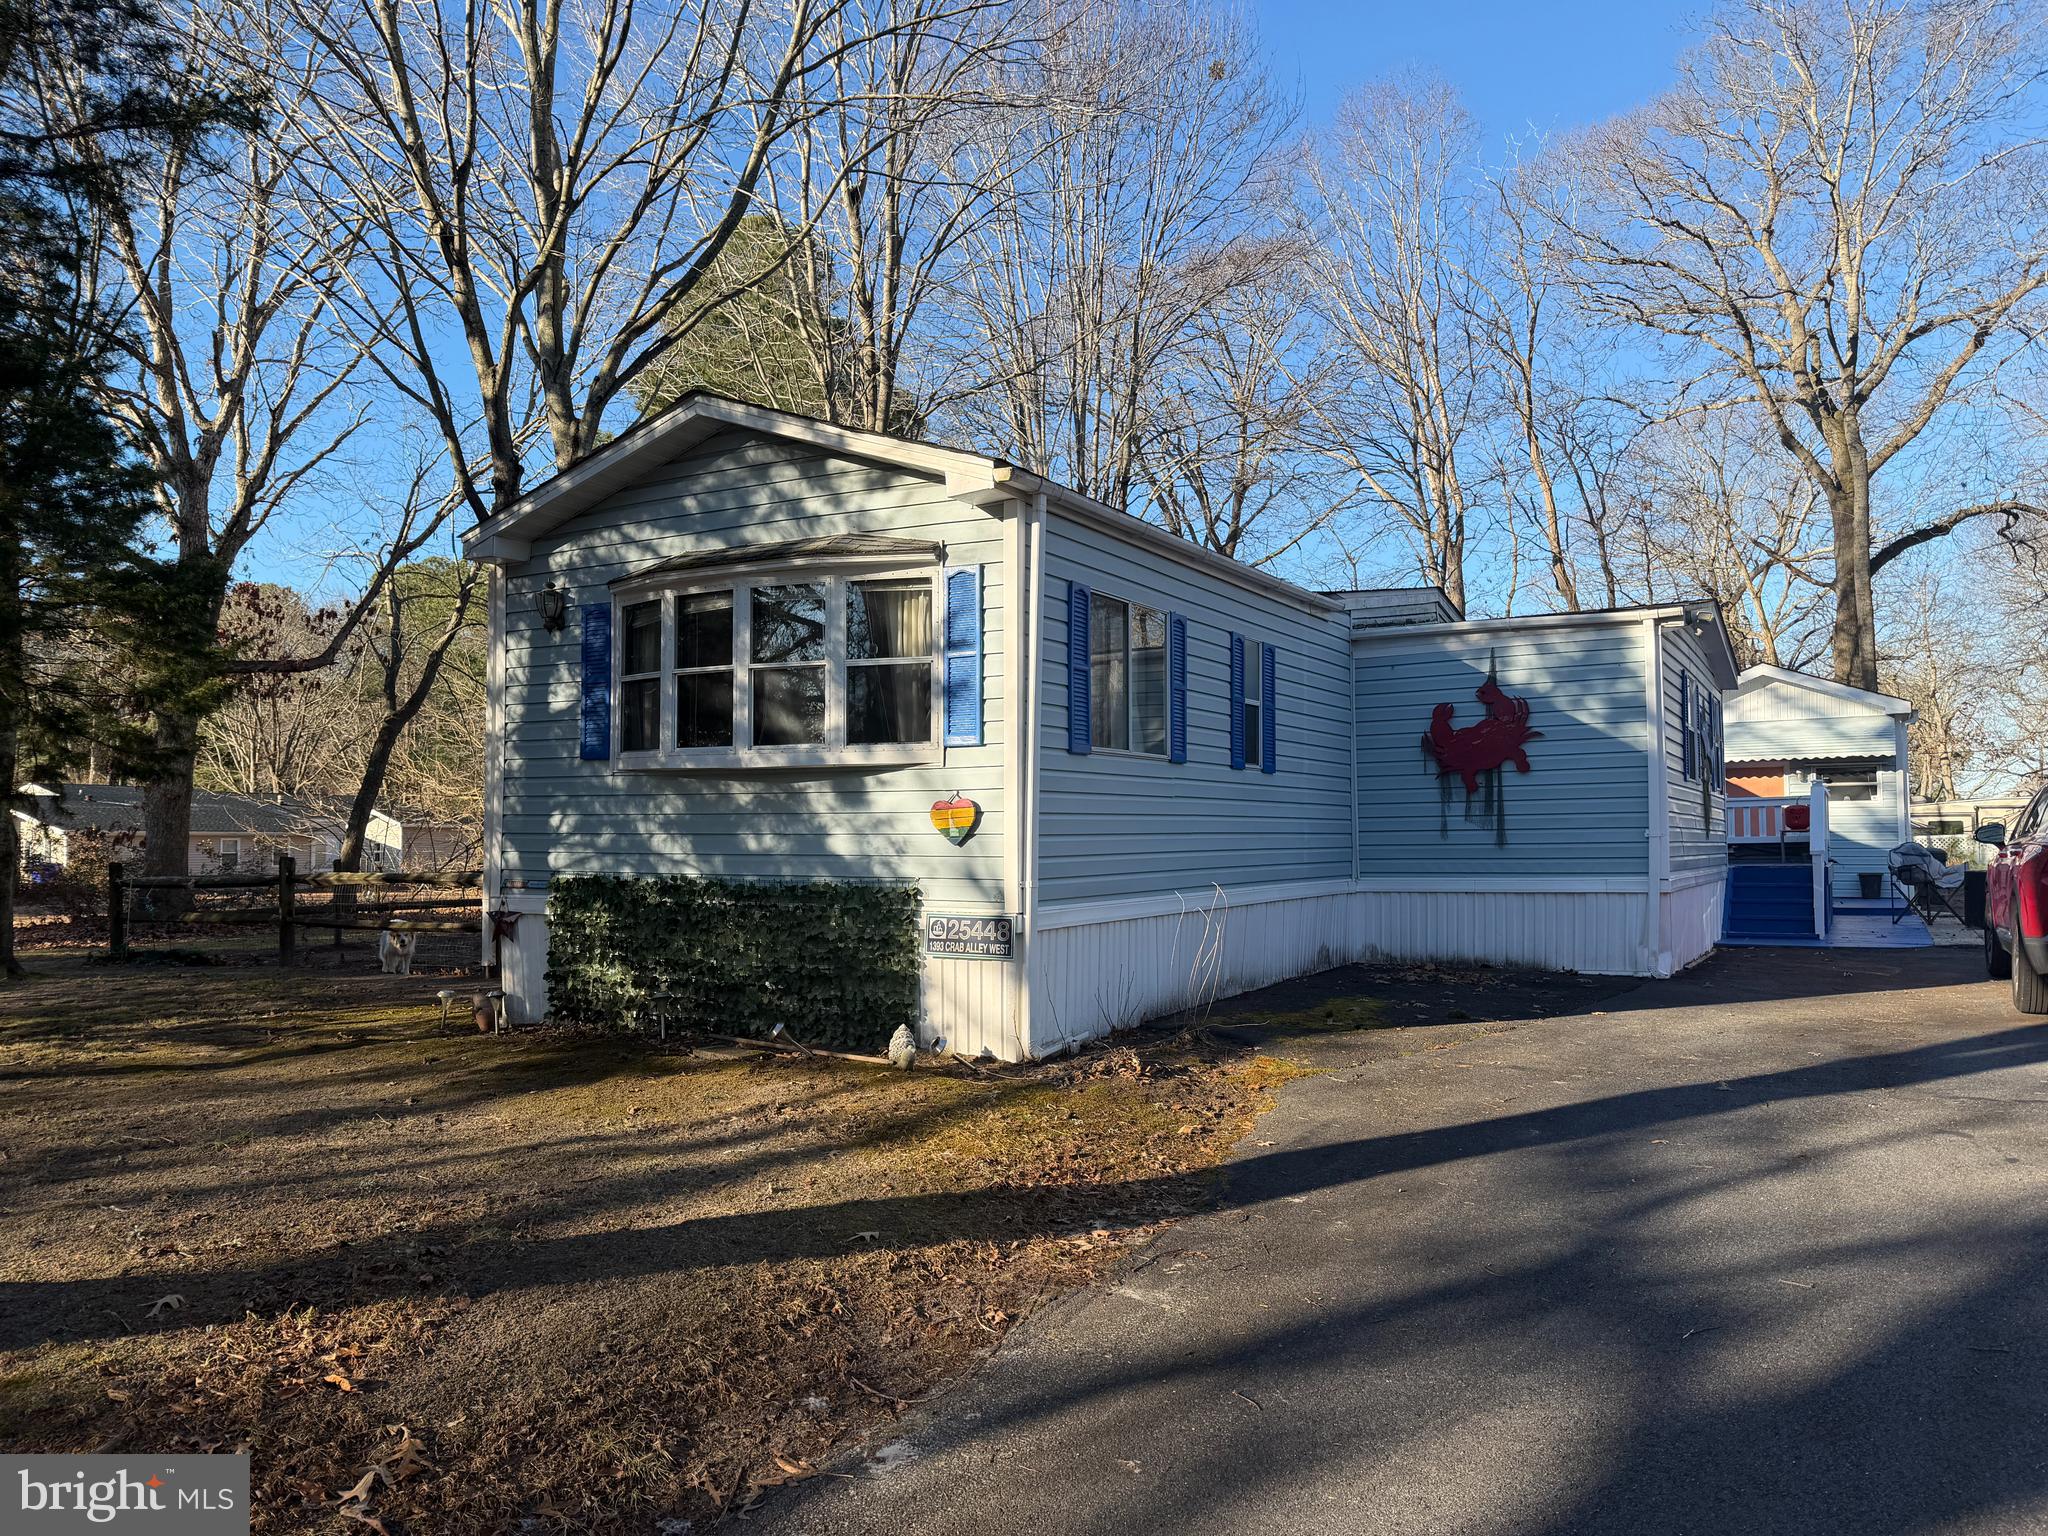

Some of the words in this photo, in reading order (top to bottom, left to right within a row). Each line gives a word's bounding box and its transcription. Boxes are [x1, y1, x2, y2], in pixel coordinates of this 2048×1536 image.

[947, 919, 1010, 941] 25448
[929, 941, 944, 952] 1393
[945, 942, 965, 952] CRAB
[965, 943, 988, 954] ALLEY
[989, 944, 1010, 955] WEST
